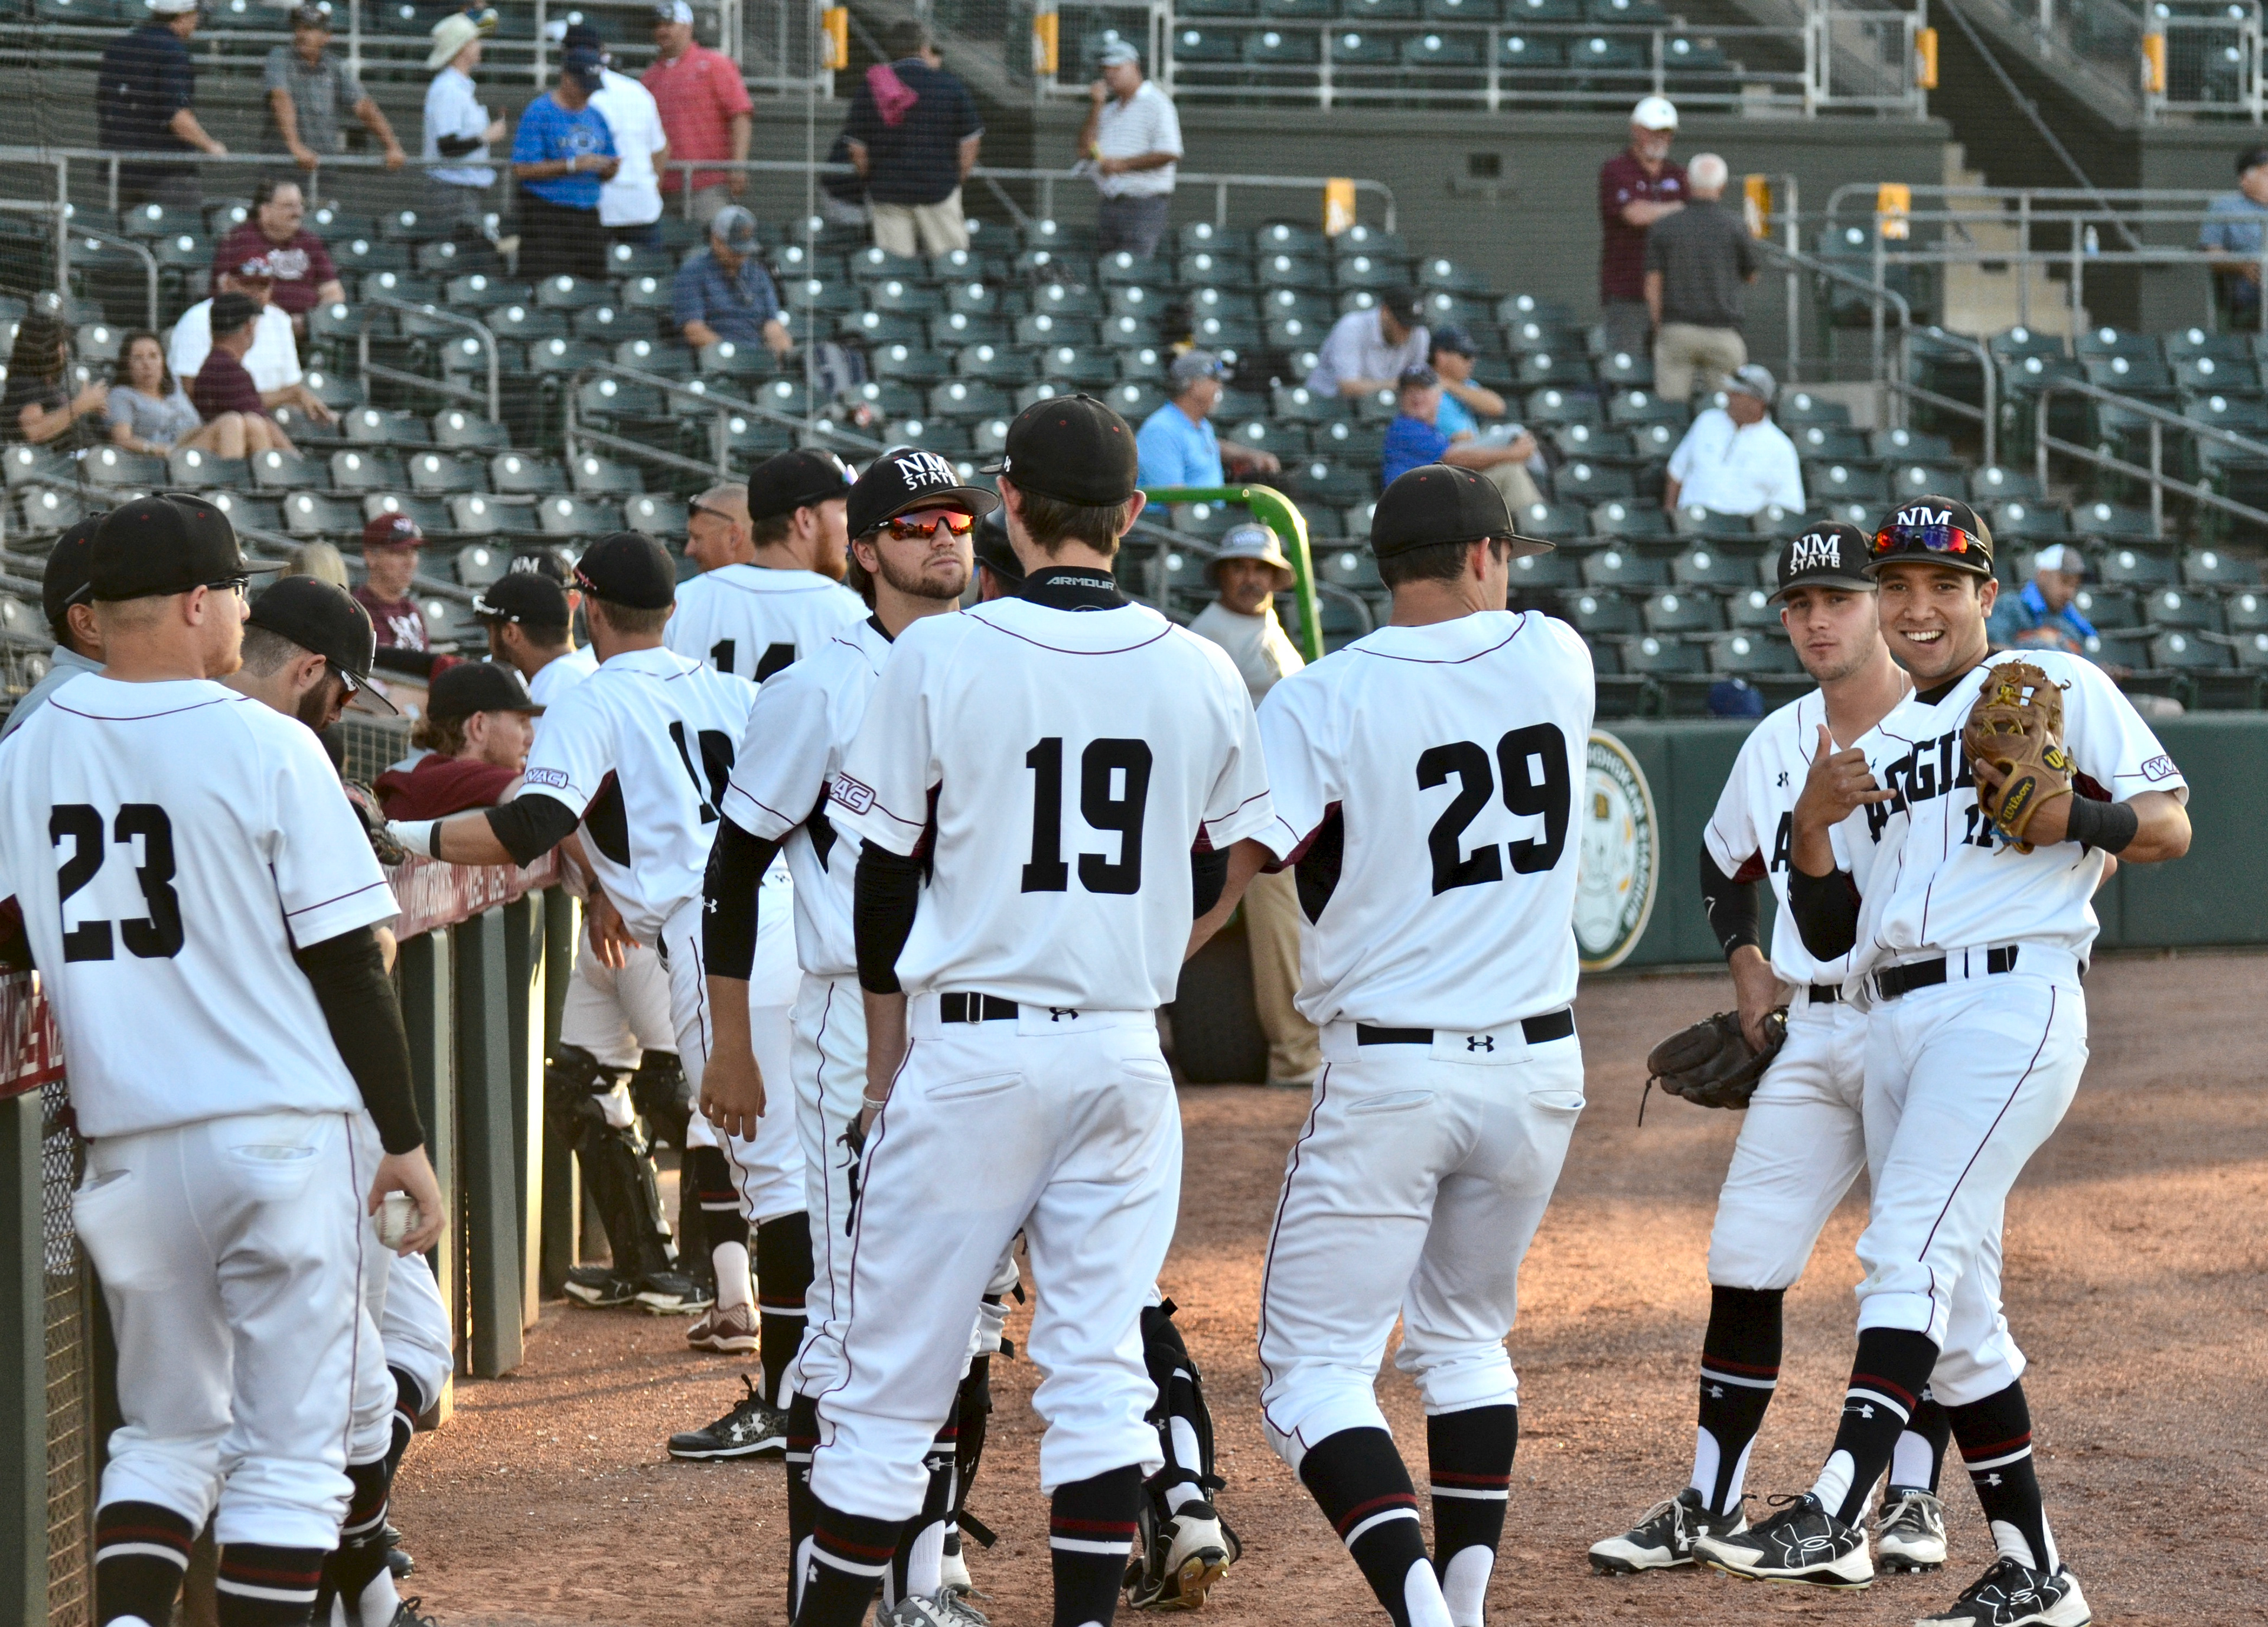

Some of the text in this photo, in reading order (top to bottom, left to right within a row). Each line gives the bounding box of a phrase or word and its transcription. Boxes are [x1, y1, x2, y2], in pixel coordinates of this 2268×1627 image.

[894, 452, 953, 480] NM
[905, 471, 959, 491] STATE
[1790, 533, 1841, 563] NM
[1790, 555, 1840, 576] STATE
[1046, 576, 1115, 591] ARMOUR
[830, 777, 871, 811] AC
[1416, 723, 1571, 896] 29
[2002, 777, 2033, 821] Wilson
[1021, 737, 1152, 895] 19
[49, 804, 184, 963] 23
